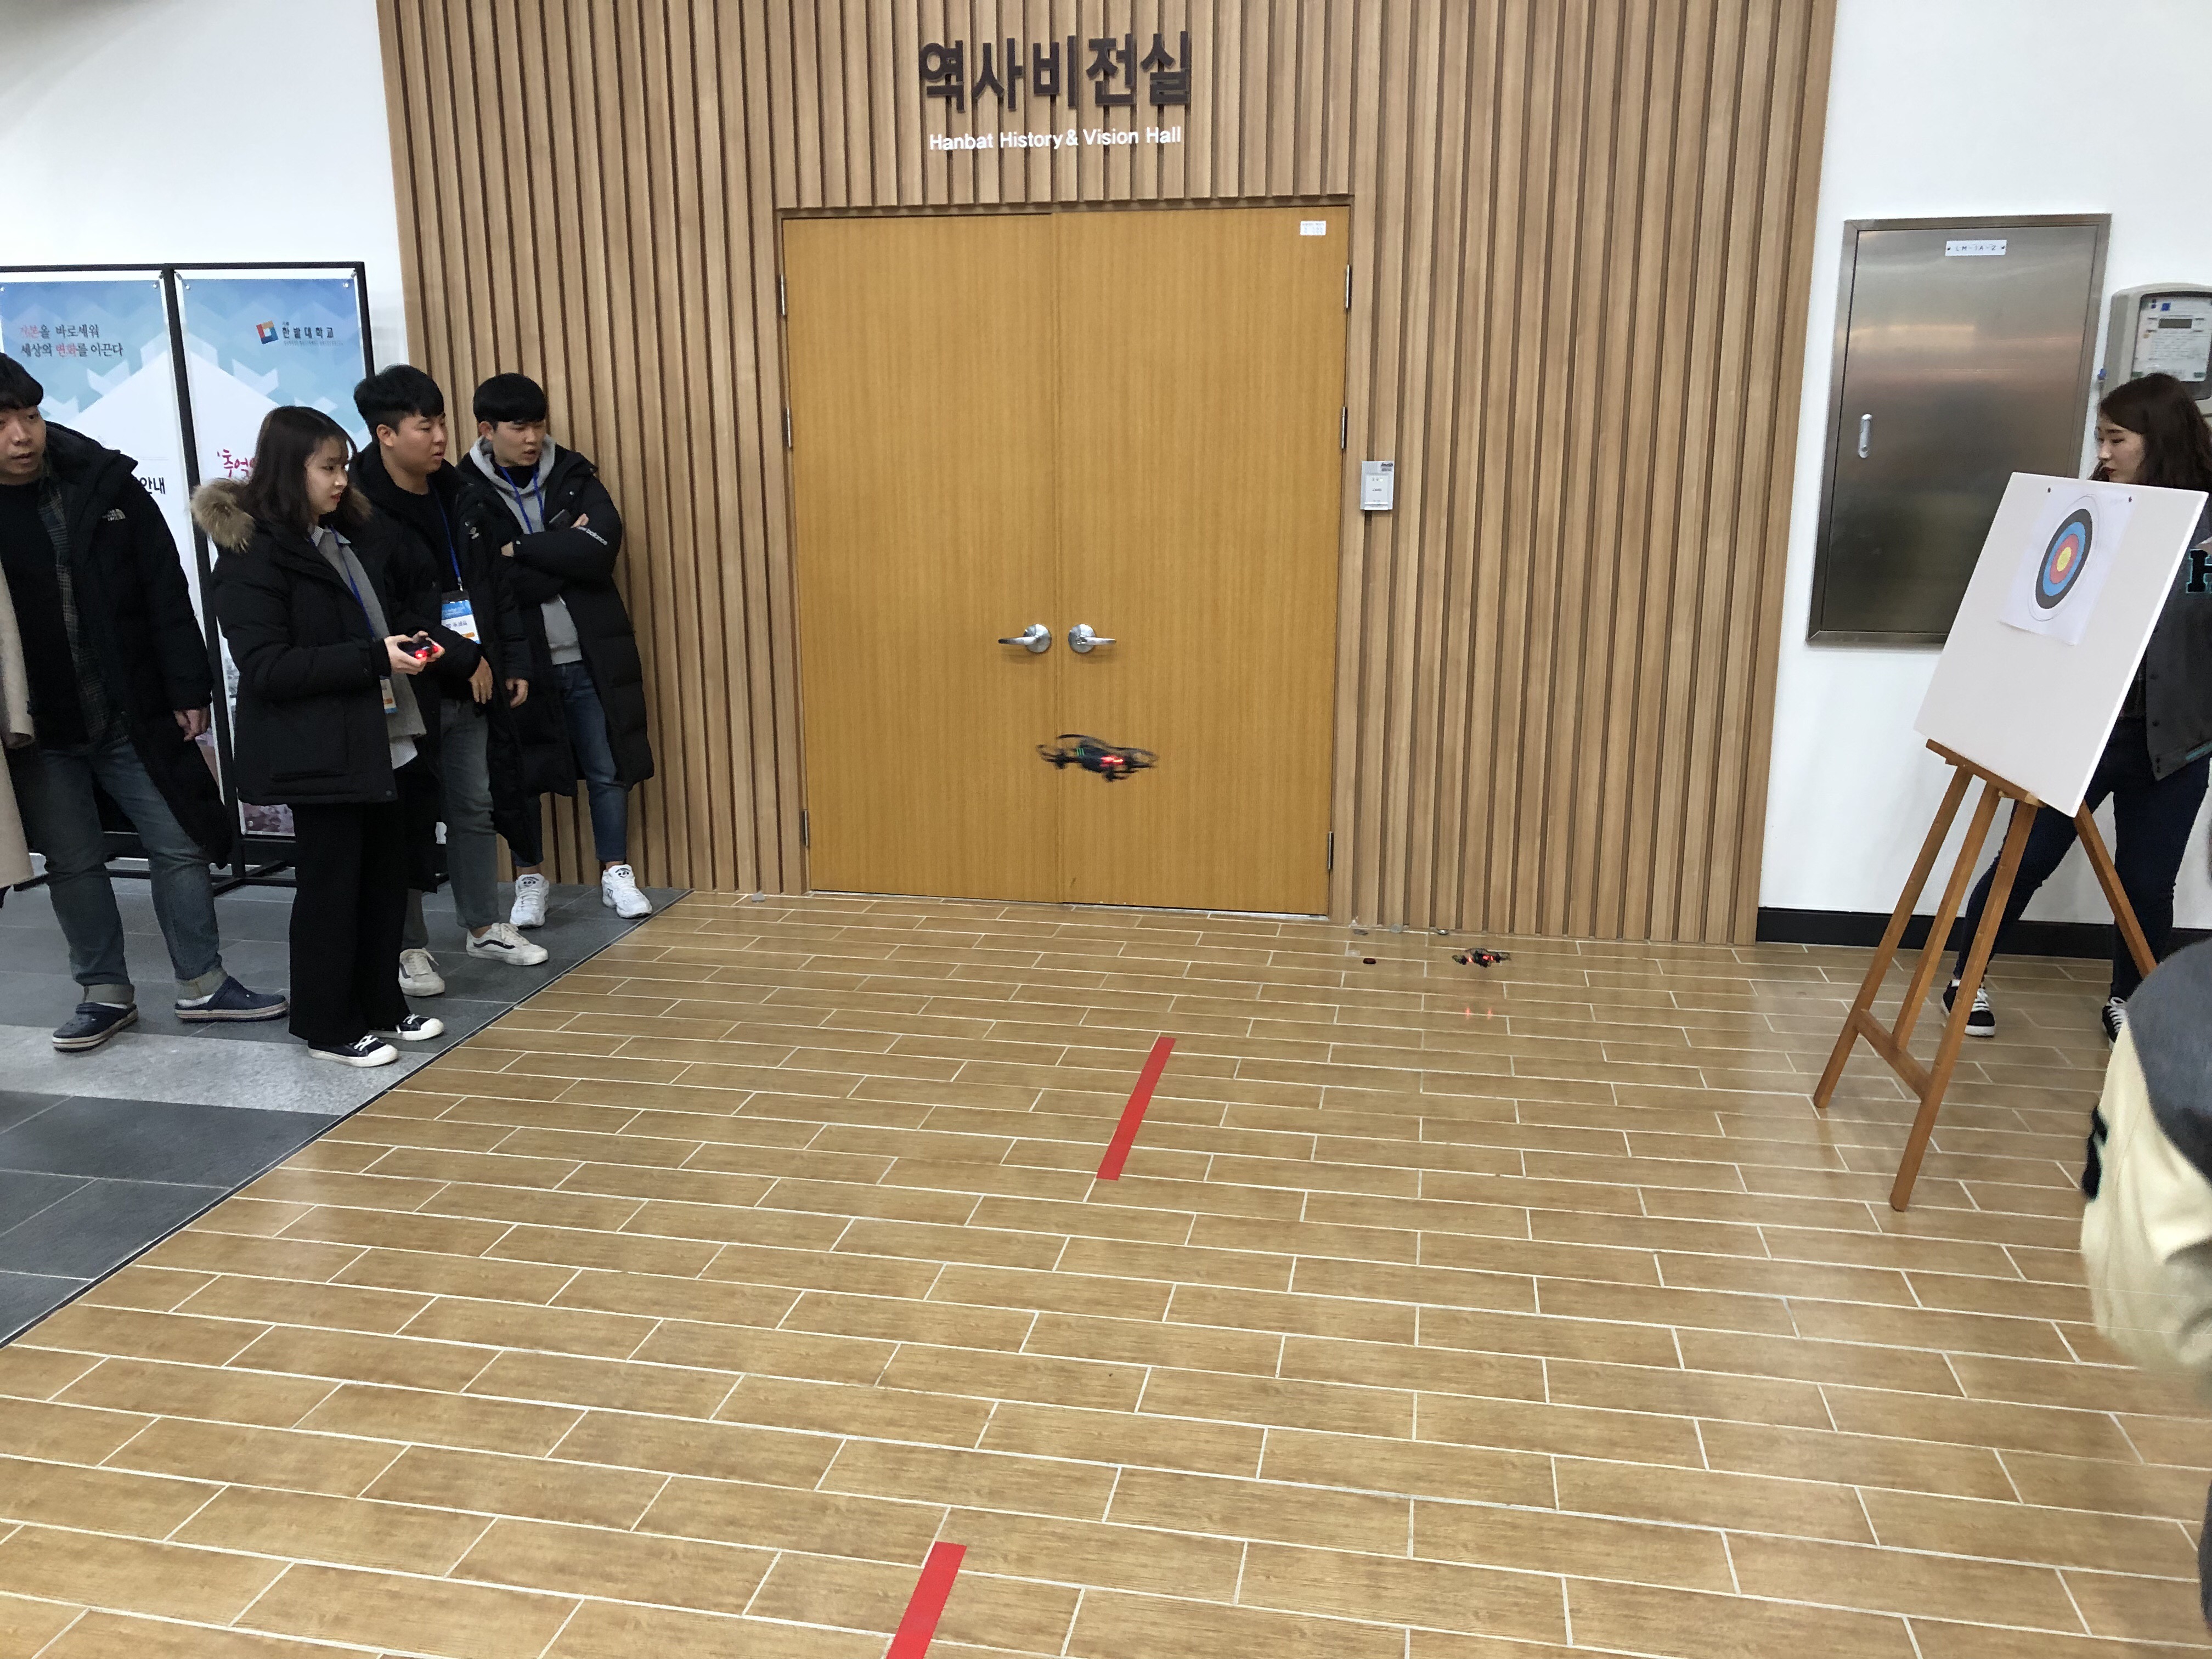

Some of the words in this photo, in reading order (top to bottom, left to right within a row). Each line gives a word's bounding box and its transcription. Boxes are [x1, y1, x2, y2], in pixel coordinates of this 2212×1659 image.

[919, 31, 1189, 114] 역사비전실
[929, 132, 994, 150] Hanbat
[1083, 128, 1139, 145] Vision
[1146, 126, 1182, 144] Hall
[55, 324, 99, 338] 바로세워
[21, 342, 53, 357] 세상의
[56, 342, 88, 357] 변화를
[91, 342, 123, 357] 이끈다
